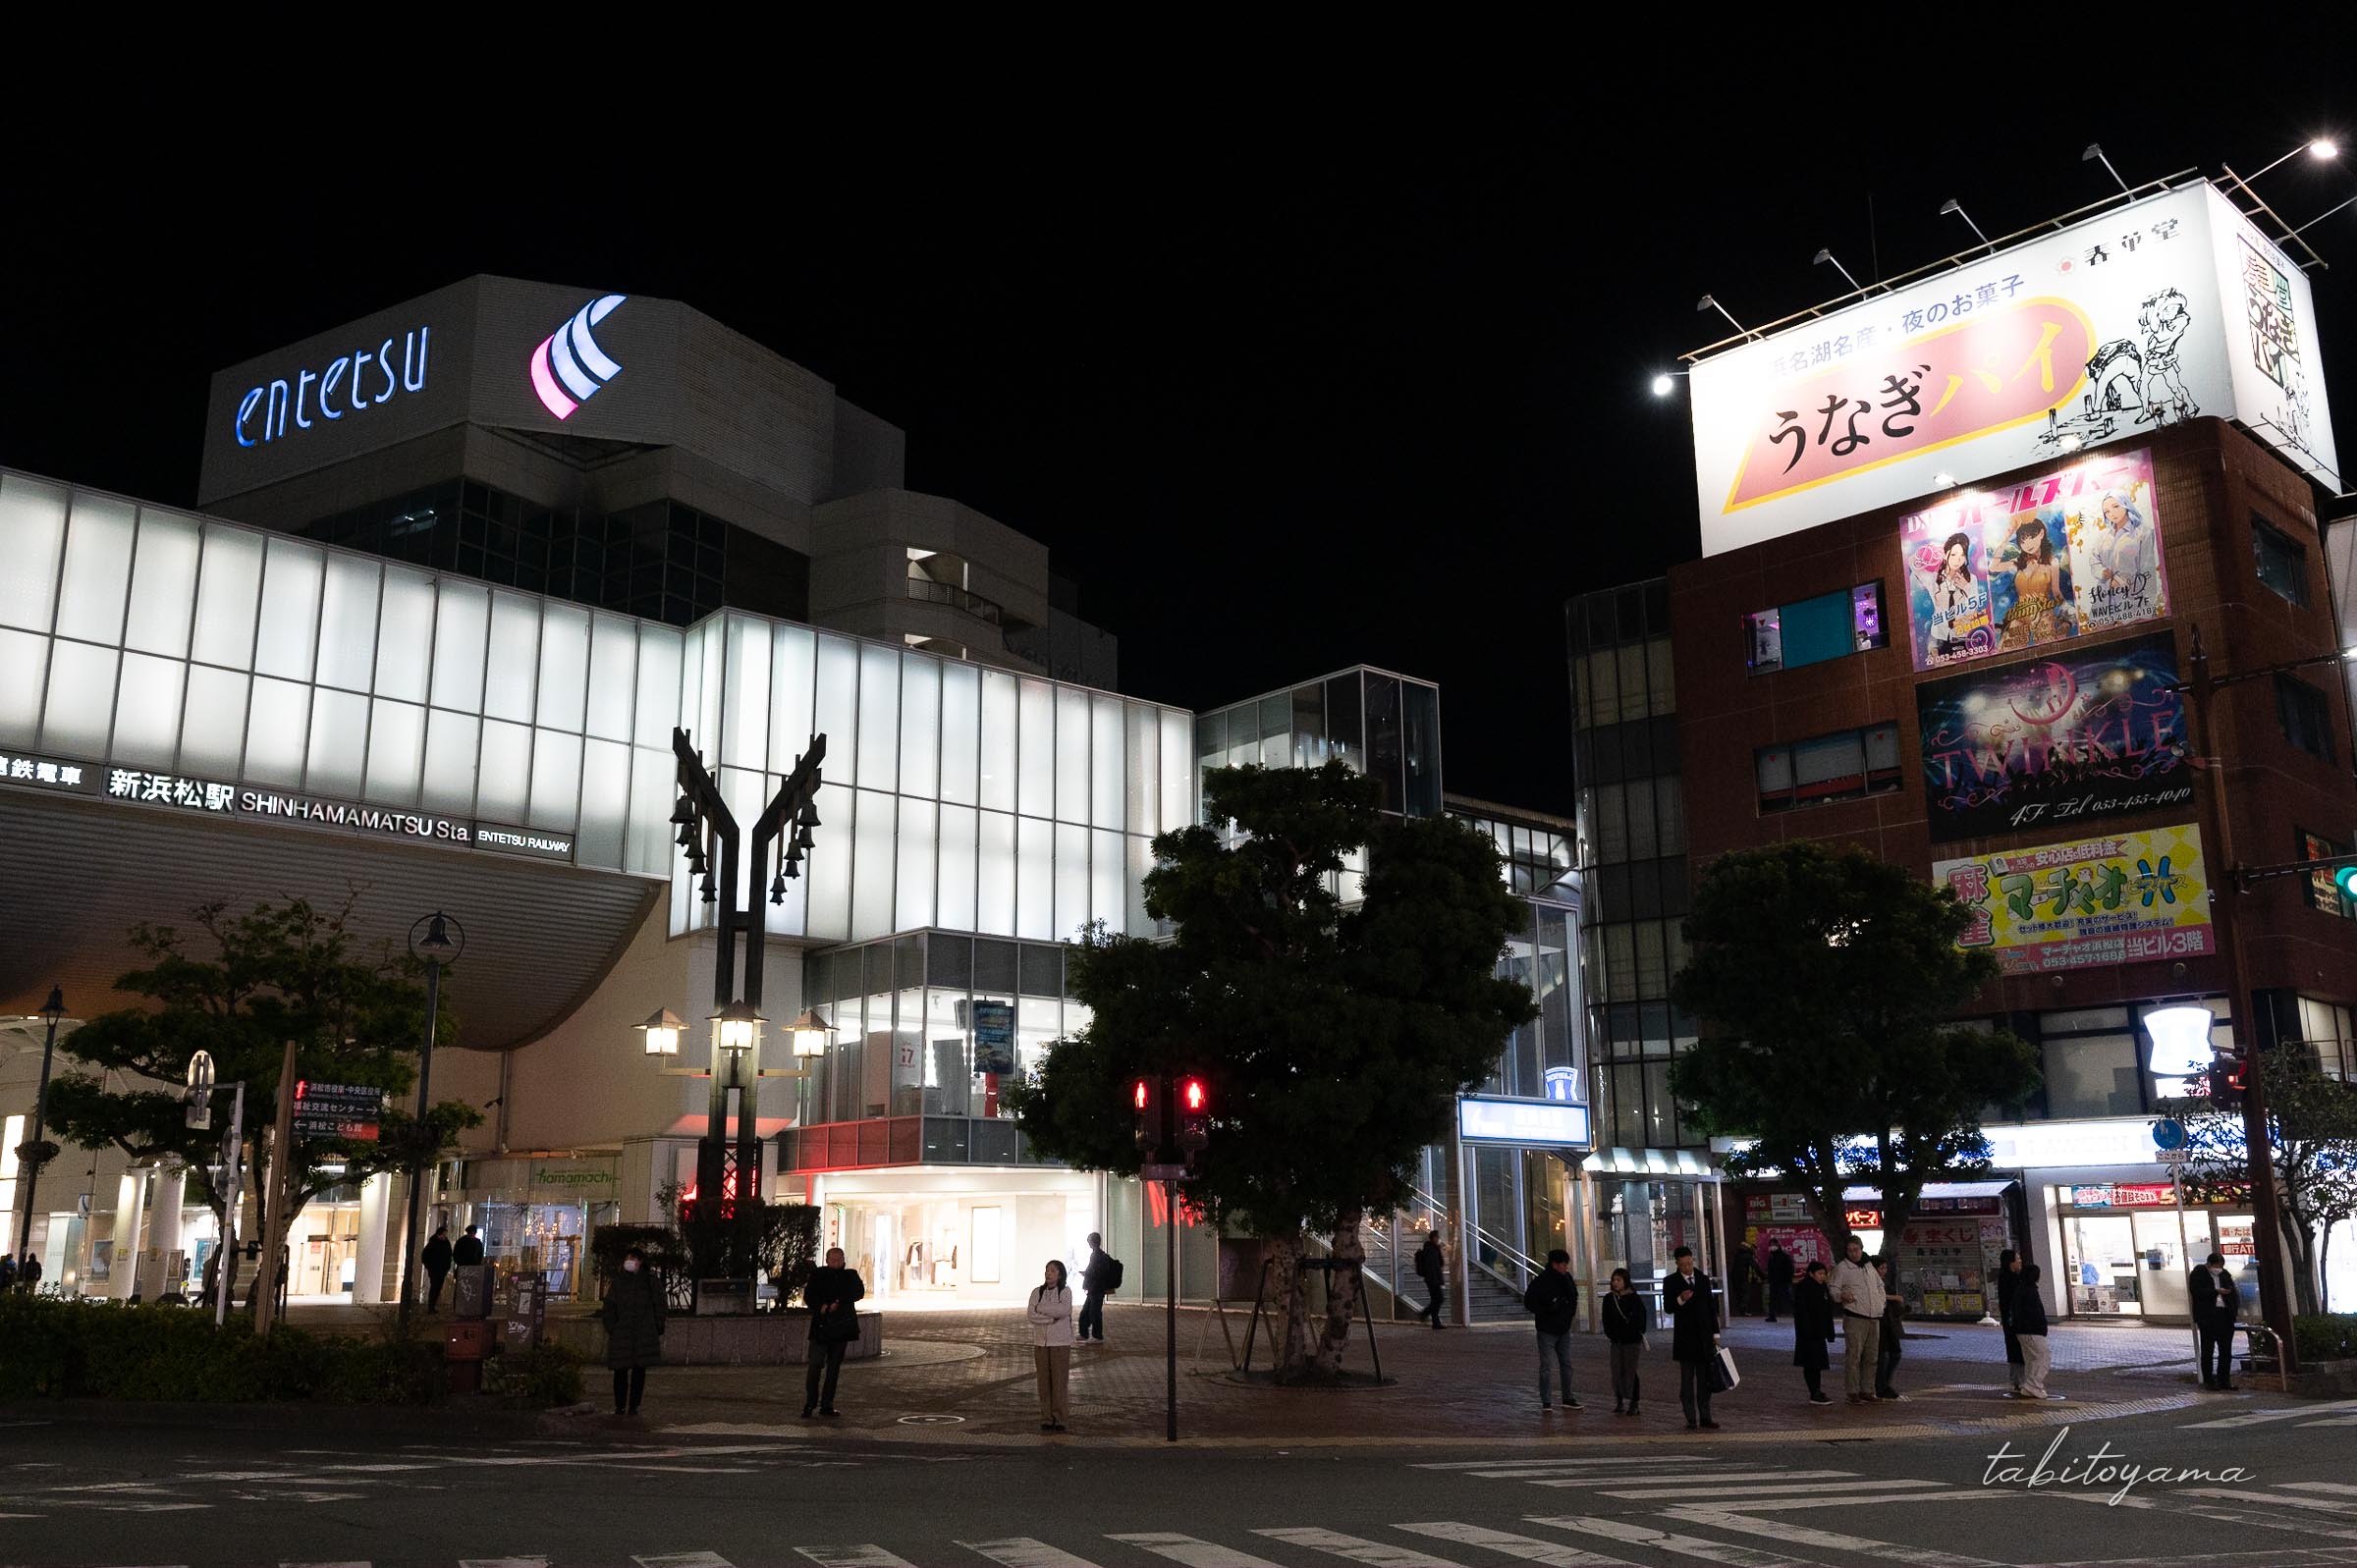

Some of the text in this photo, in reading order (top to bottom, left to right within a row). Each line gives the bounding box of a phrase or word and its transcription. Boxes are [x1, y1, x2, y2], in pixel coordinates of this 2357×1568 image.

[235, 326, 429, 448] entetsu
[1769, 320, 2062, 475] うなぎパイ
[1932, 591, 1988, 626] 当ビル5F
[1932, 710, 2173, 789] TWINKLE
[109, 769, 235, 811] 新浜松駅
[2010, 786, 2191, 827] 4F Tel 053-455-4040
[242, 791, 471, 841] SHINHAMAMATSU Sta.
[478, 831, 571, 852] ENTETSU RAILWAY
[2000, 863, 2128, 920] マーチャオ
[2127, 929, 2204, 958] 当ビル3階
[2223, 1244, 2255, 1254] 銀行AT
